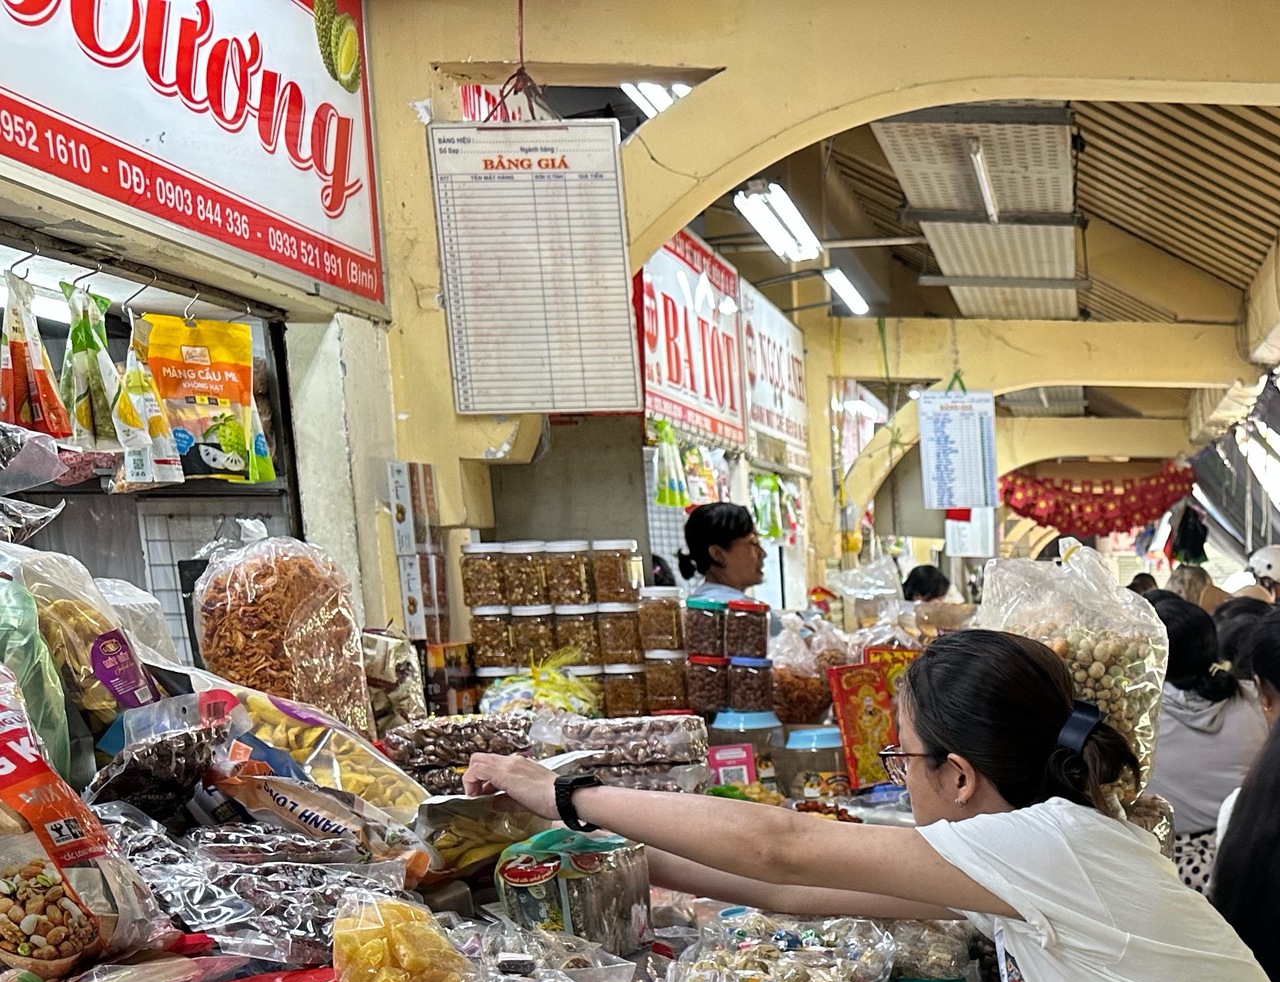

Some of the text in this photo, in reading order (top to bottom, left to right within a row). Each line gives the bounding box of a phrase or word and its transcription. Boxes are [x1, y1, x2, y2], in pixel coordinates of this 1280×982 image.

[482, 154, 570, 171] BẢNG GIÁ
[44, 128, 91, 174] 1610
[118, 158, 152, 199] DĐ:
[155, 176, 193, 216] 0903
[196, 194, 223, 229] 844
[225, 207, 250, 240] 336
[268, 226, 298, 261] 0933
[300, 241, 321, 269] 521
[323, 251, 343, 279] 991
[661, 291, 698, 394] BA
[162, 366, 196, 379] MÃNG
[198, 366, 222, 382] CẦU
[263, 781, 353, 836] HANH LONG
